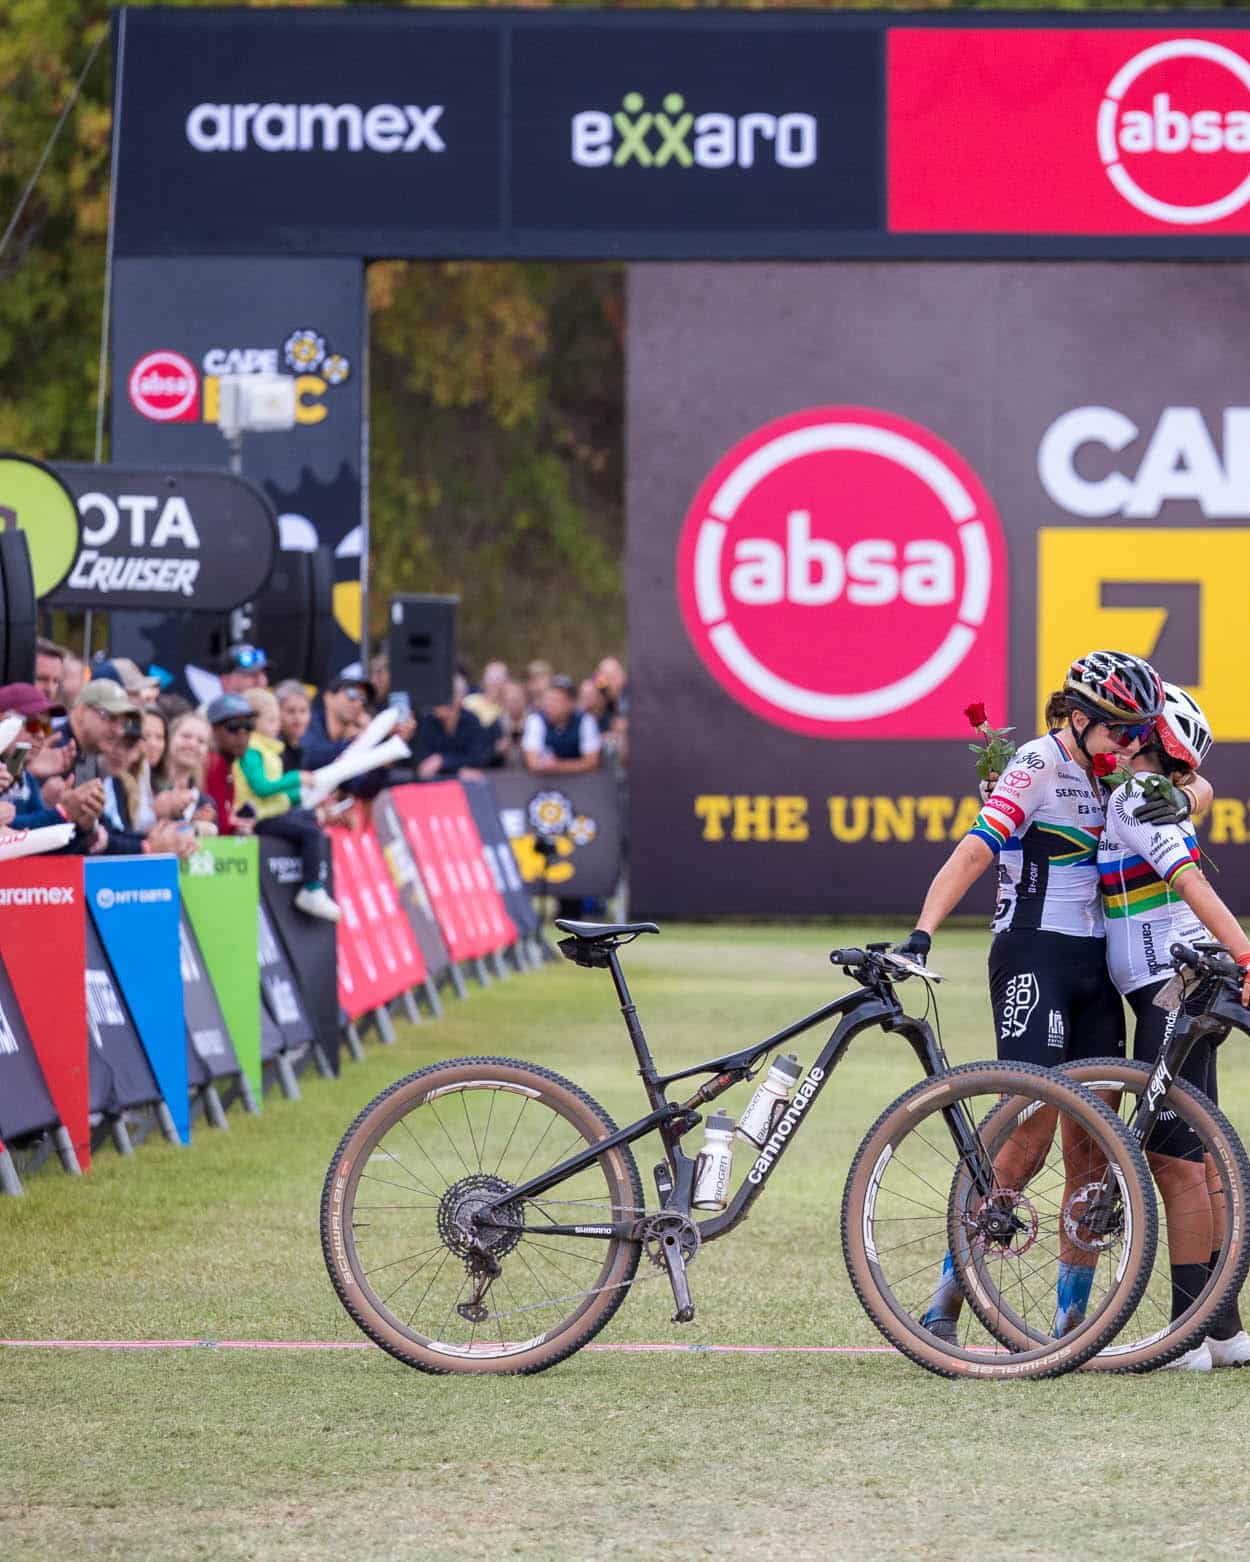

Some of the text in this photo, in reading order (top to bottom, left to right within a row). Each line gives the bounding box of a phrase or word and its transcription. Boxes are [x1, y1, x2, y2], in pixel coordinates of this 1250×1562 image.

[186, 103, 446, 152] aramex
[572, 93, 818, 168] exxaro
[203, 349, 278, 376] CAPE
[68, 551, 201, 596] CRUISER
[730, 511, 956, 607] absa
[695, 795, 810, 841] THE
[1001, 975, 1016, 1040] TOYOTA
[1013, 973, 1032, 1038] ROLA
[748, 1066, 825, 1184] cannondale
[332, 1175, 354, 1285] SCHWALBE
